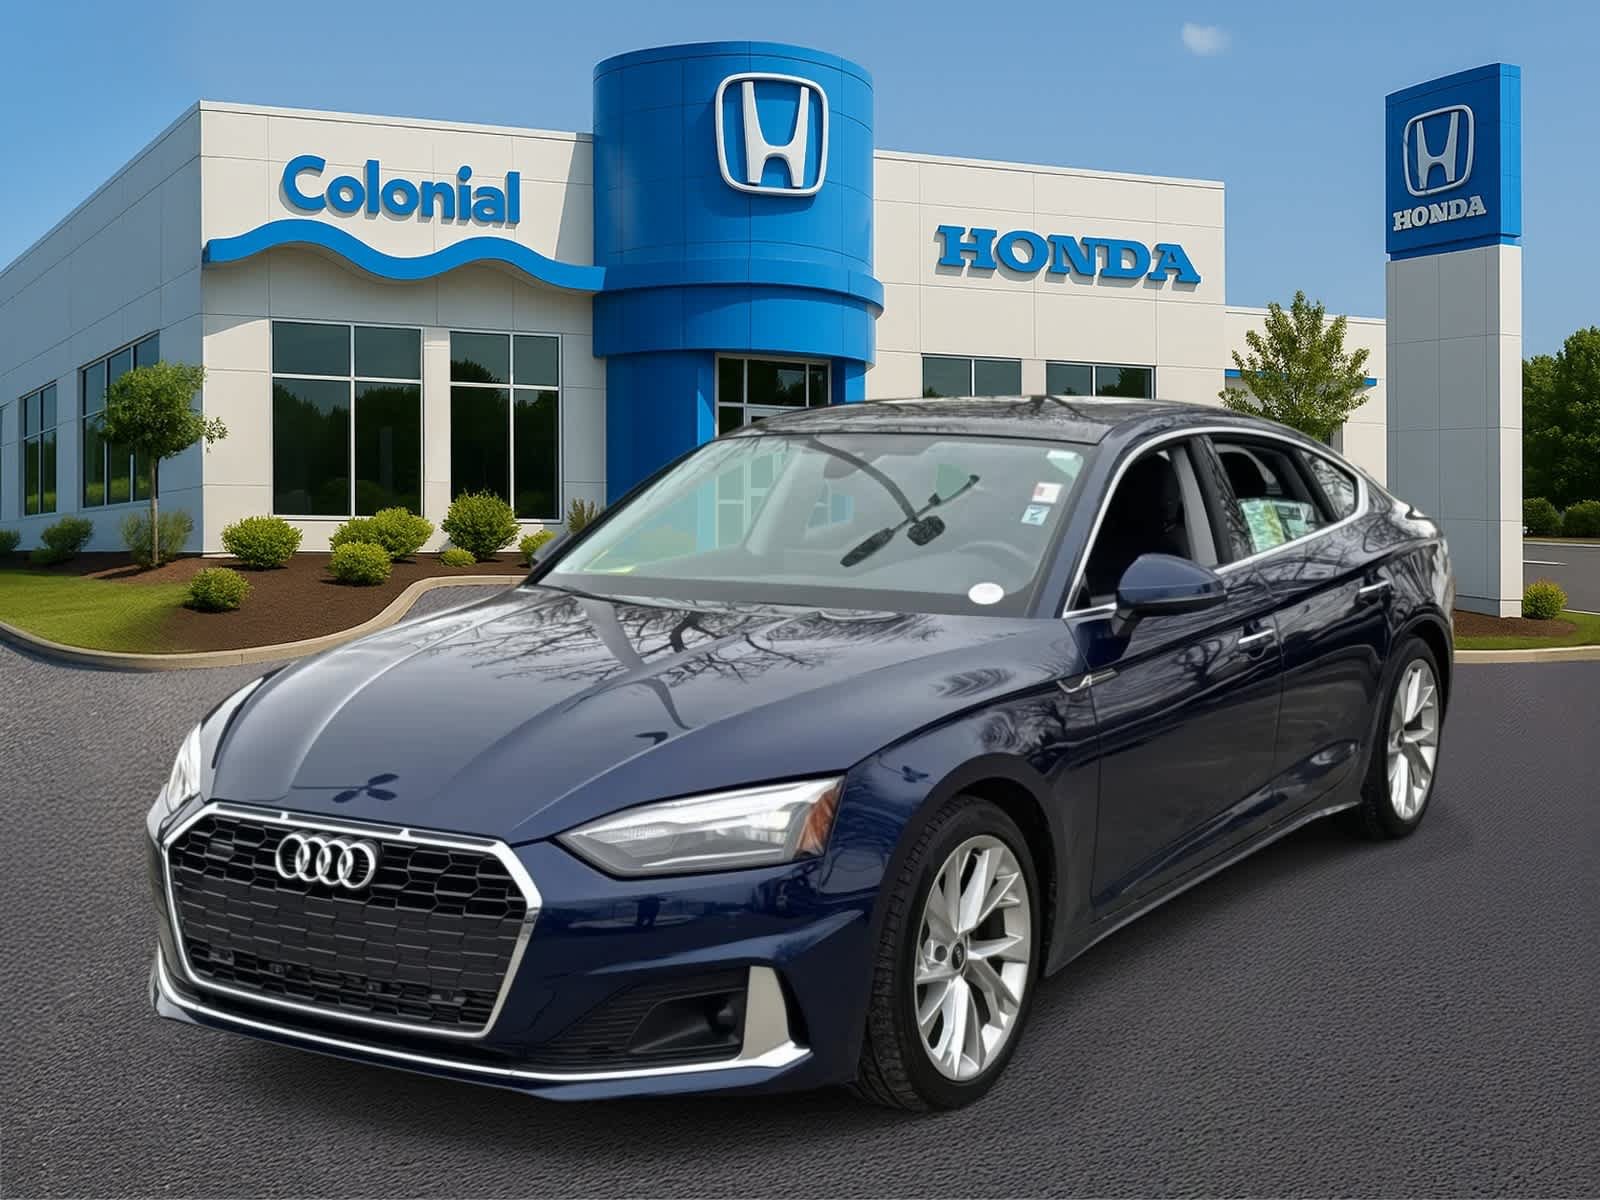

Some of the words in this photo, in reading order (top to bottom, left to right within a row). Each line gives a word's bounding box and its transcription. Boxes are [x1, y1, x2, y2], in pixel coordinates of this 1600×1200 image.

[282, 154, 521, 225] Colonial
[1392, 195, 1487, 232] HONDA
[936, 224, 1202, 285] HONDA
